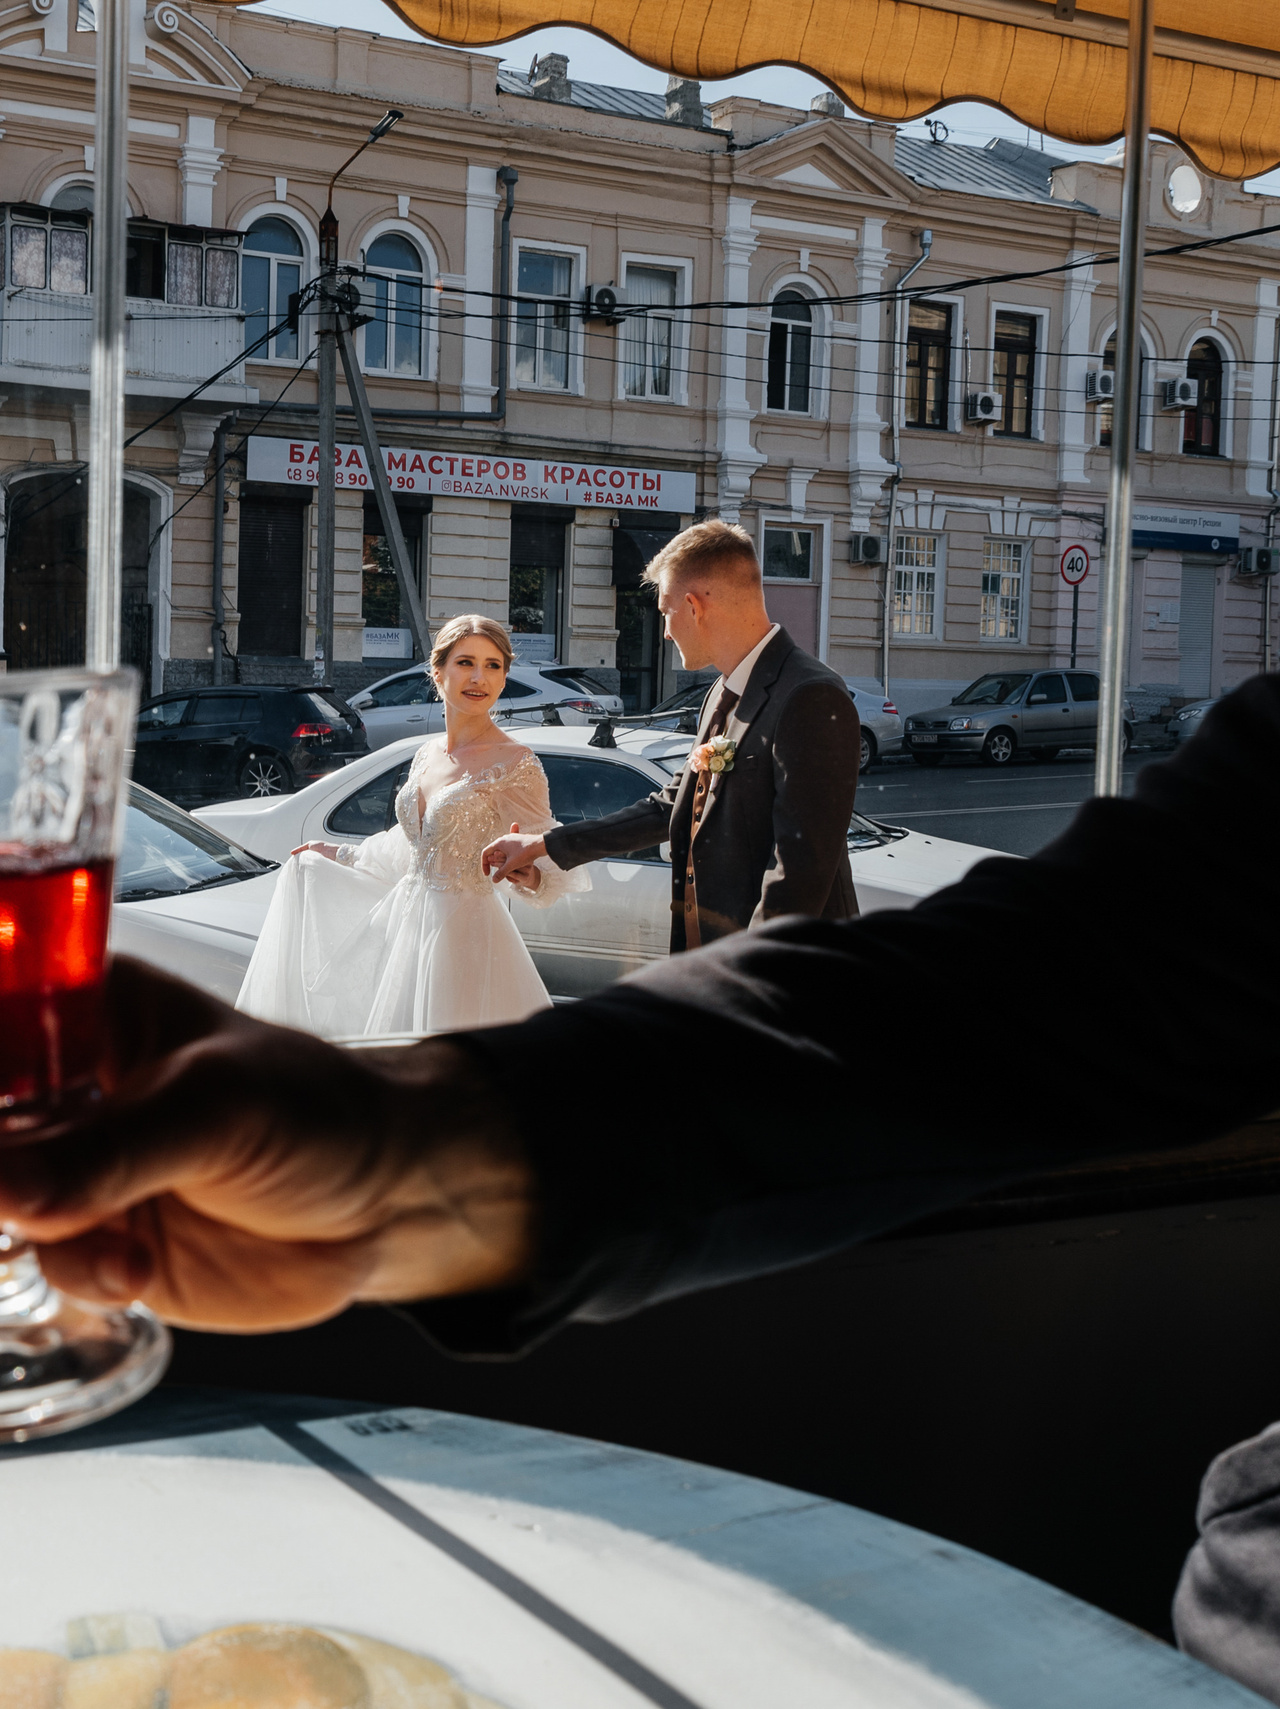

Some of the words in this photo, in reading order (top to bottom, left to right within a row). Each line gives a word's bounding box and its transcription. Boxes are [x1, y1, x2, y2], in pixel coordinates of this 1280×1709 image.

[293, 468, 302, 482] 8
[348, 473, 368, 487] 90
[396, 476, 415, 490] 90
[387, 452, 527, 482] МАСТЕРОВ
[543, 465, 662, 492] КРАСОТЫ
[453, 480, 549, 500] BAZA.NVRSK
[637, 494, 659, 508] МК
[1178, 517, 1198, 527] центр
[1198, 517, 1222, 529] Греции
[1067, 556, 1084, 573] 40
